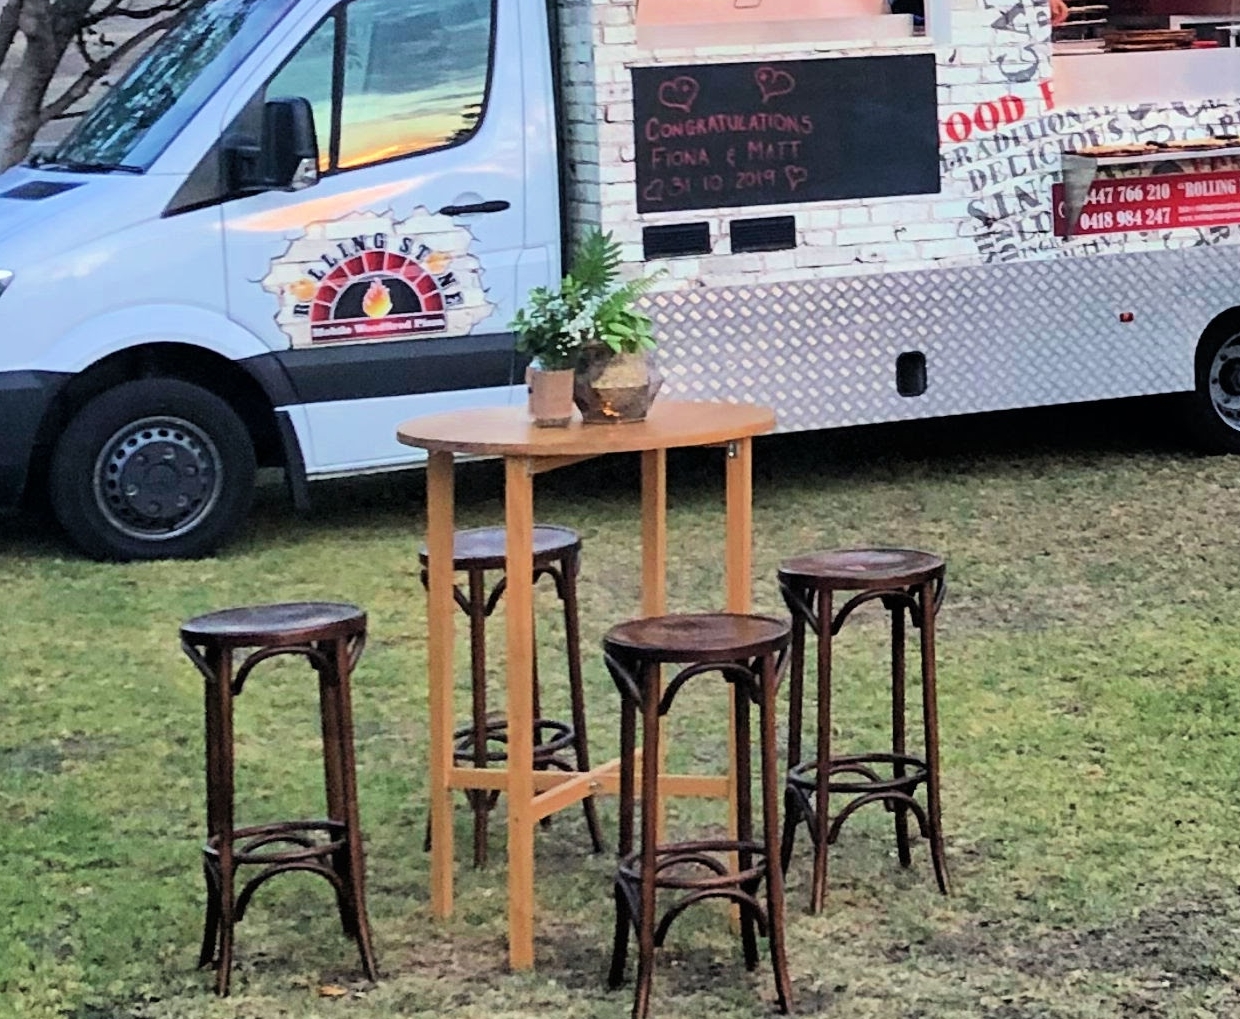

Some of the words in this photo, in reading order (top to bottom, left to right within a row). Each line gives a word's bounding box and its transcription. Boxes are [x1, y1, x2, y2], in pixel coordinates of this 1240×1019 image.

[645, 112, 813, 142] CONGRATULATIONS
[937, 94, 1024, 146] OOD
[651, 145, 710, 170] FIONA
[747, 139, 801, 162] MATT
[703, 174, 724, 193] 10
[735, 169, 777, 191] 2019
[1083, 186, 1114, 206] 447
[1117, 184, 1144, 203] 766
[1146, 182, 1172, 201] 210
[1080, 211, 1114, 231] 0418
[1116, 209, 1143, 228] 984
[1145, 206, 1172, 226] 247
